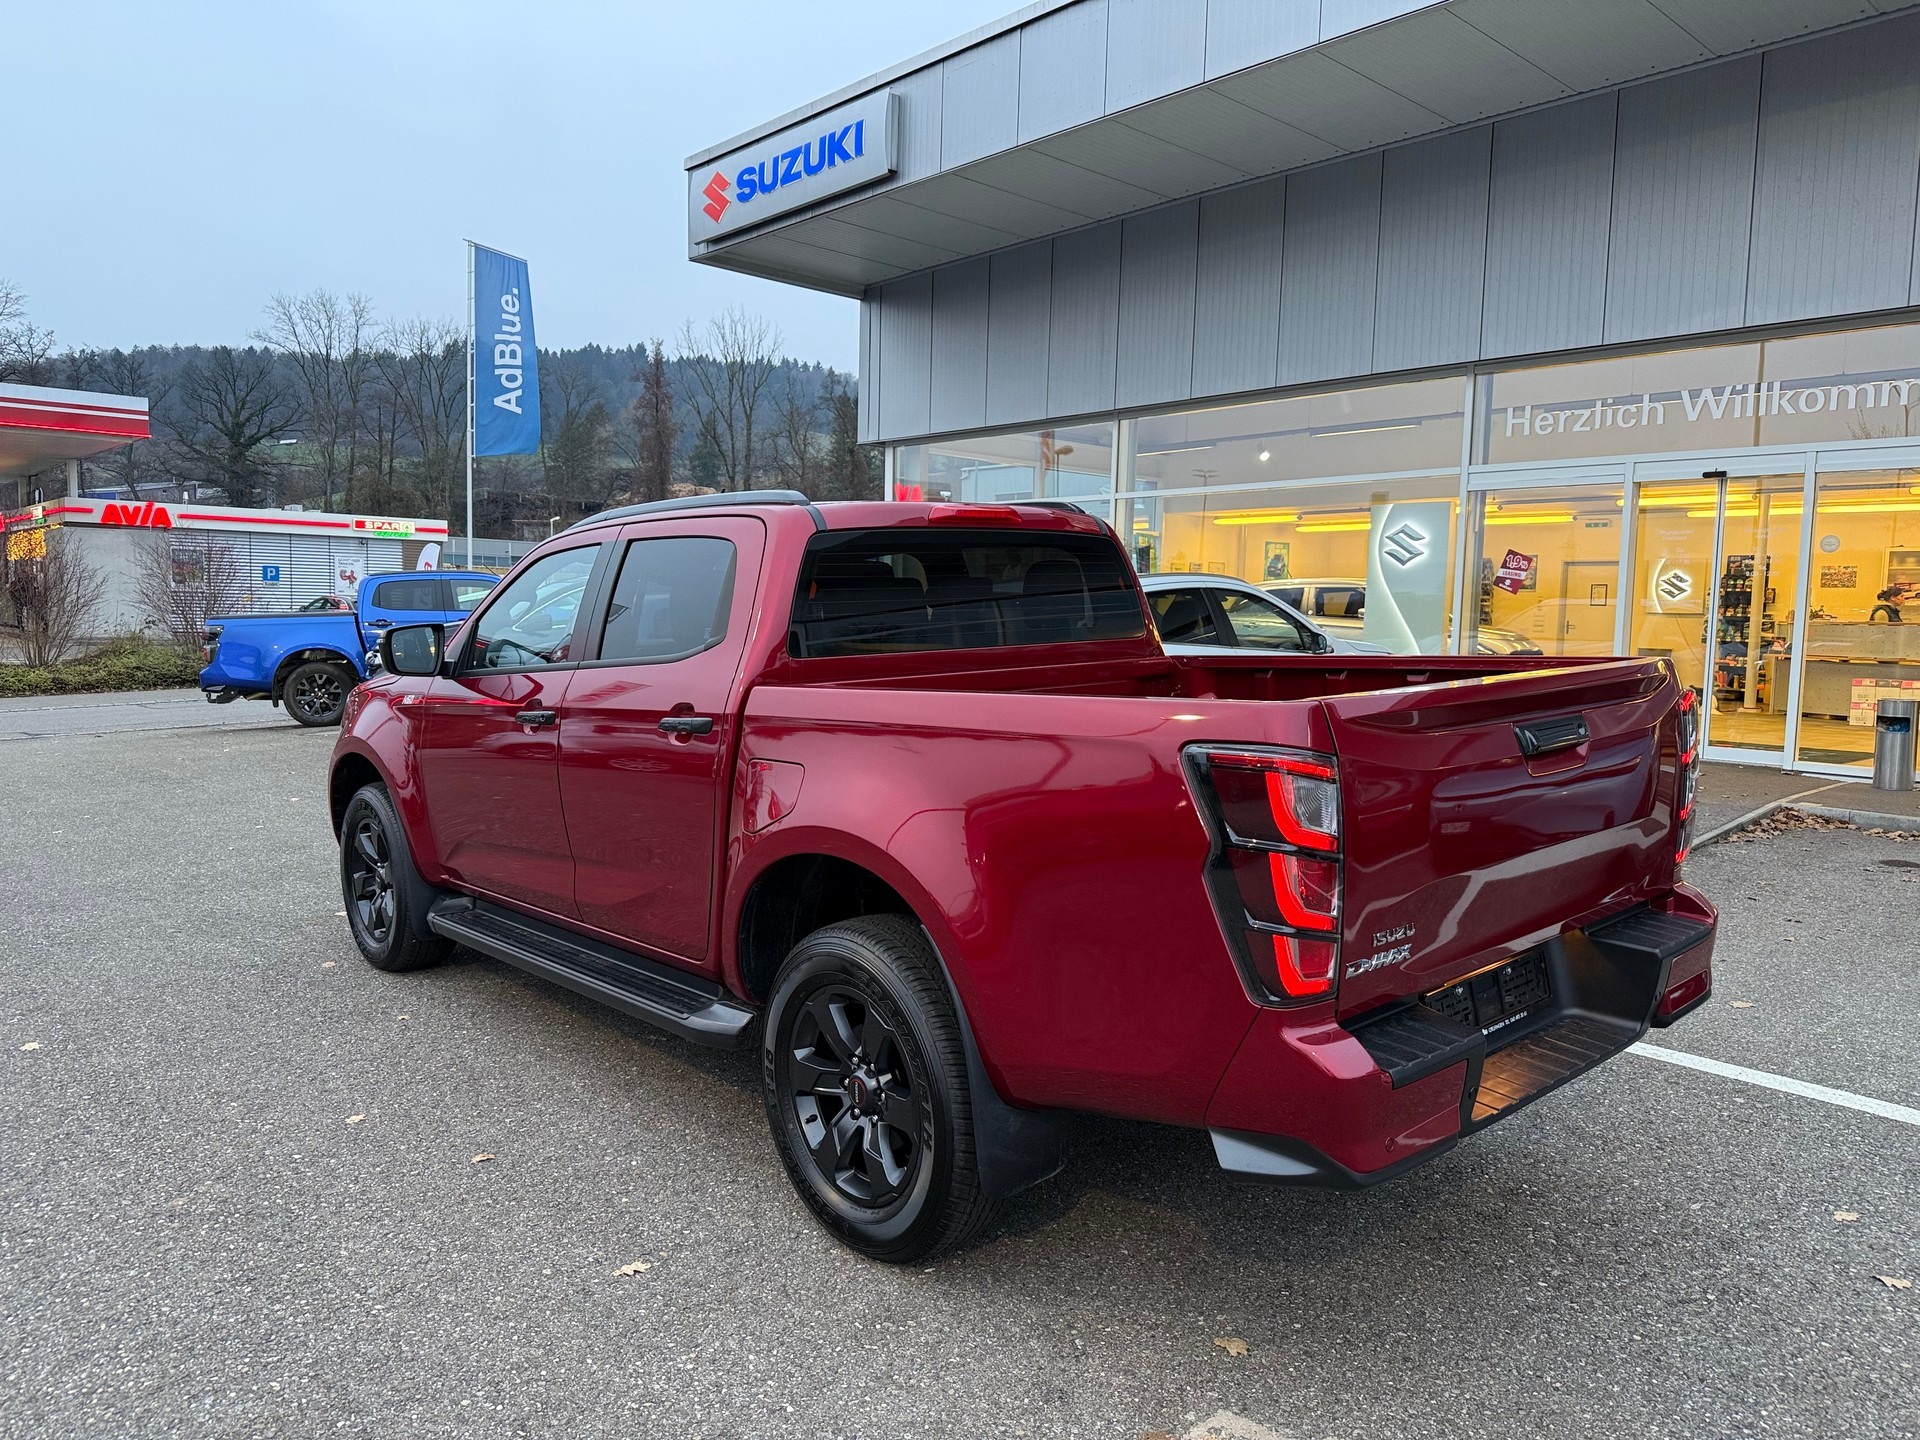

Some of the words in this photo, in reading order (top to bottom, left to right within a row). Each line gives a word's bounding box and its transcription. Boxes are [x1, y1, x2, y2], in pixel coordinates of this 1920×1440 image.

[736, 119, 865, 203] SUZUKI
[1506, 394, 1665, 437] Herzlich
[101, 501, 172, 528] AVIA
[364, 521, 400, 530] SPAR
[267, 567, 276, 580] P
[1502, 570, 1522, 578] LEASING
[1372, 922, 1416, 947] ISUZU
